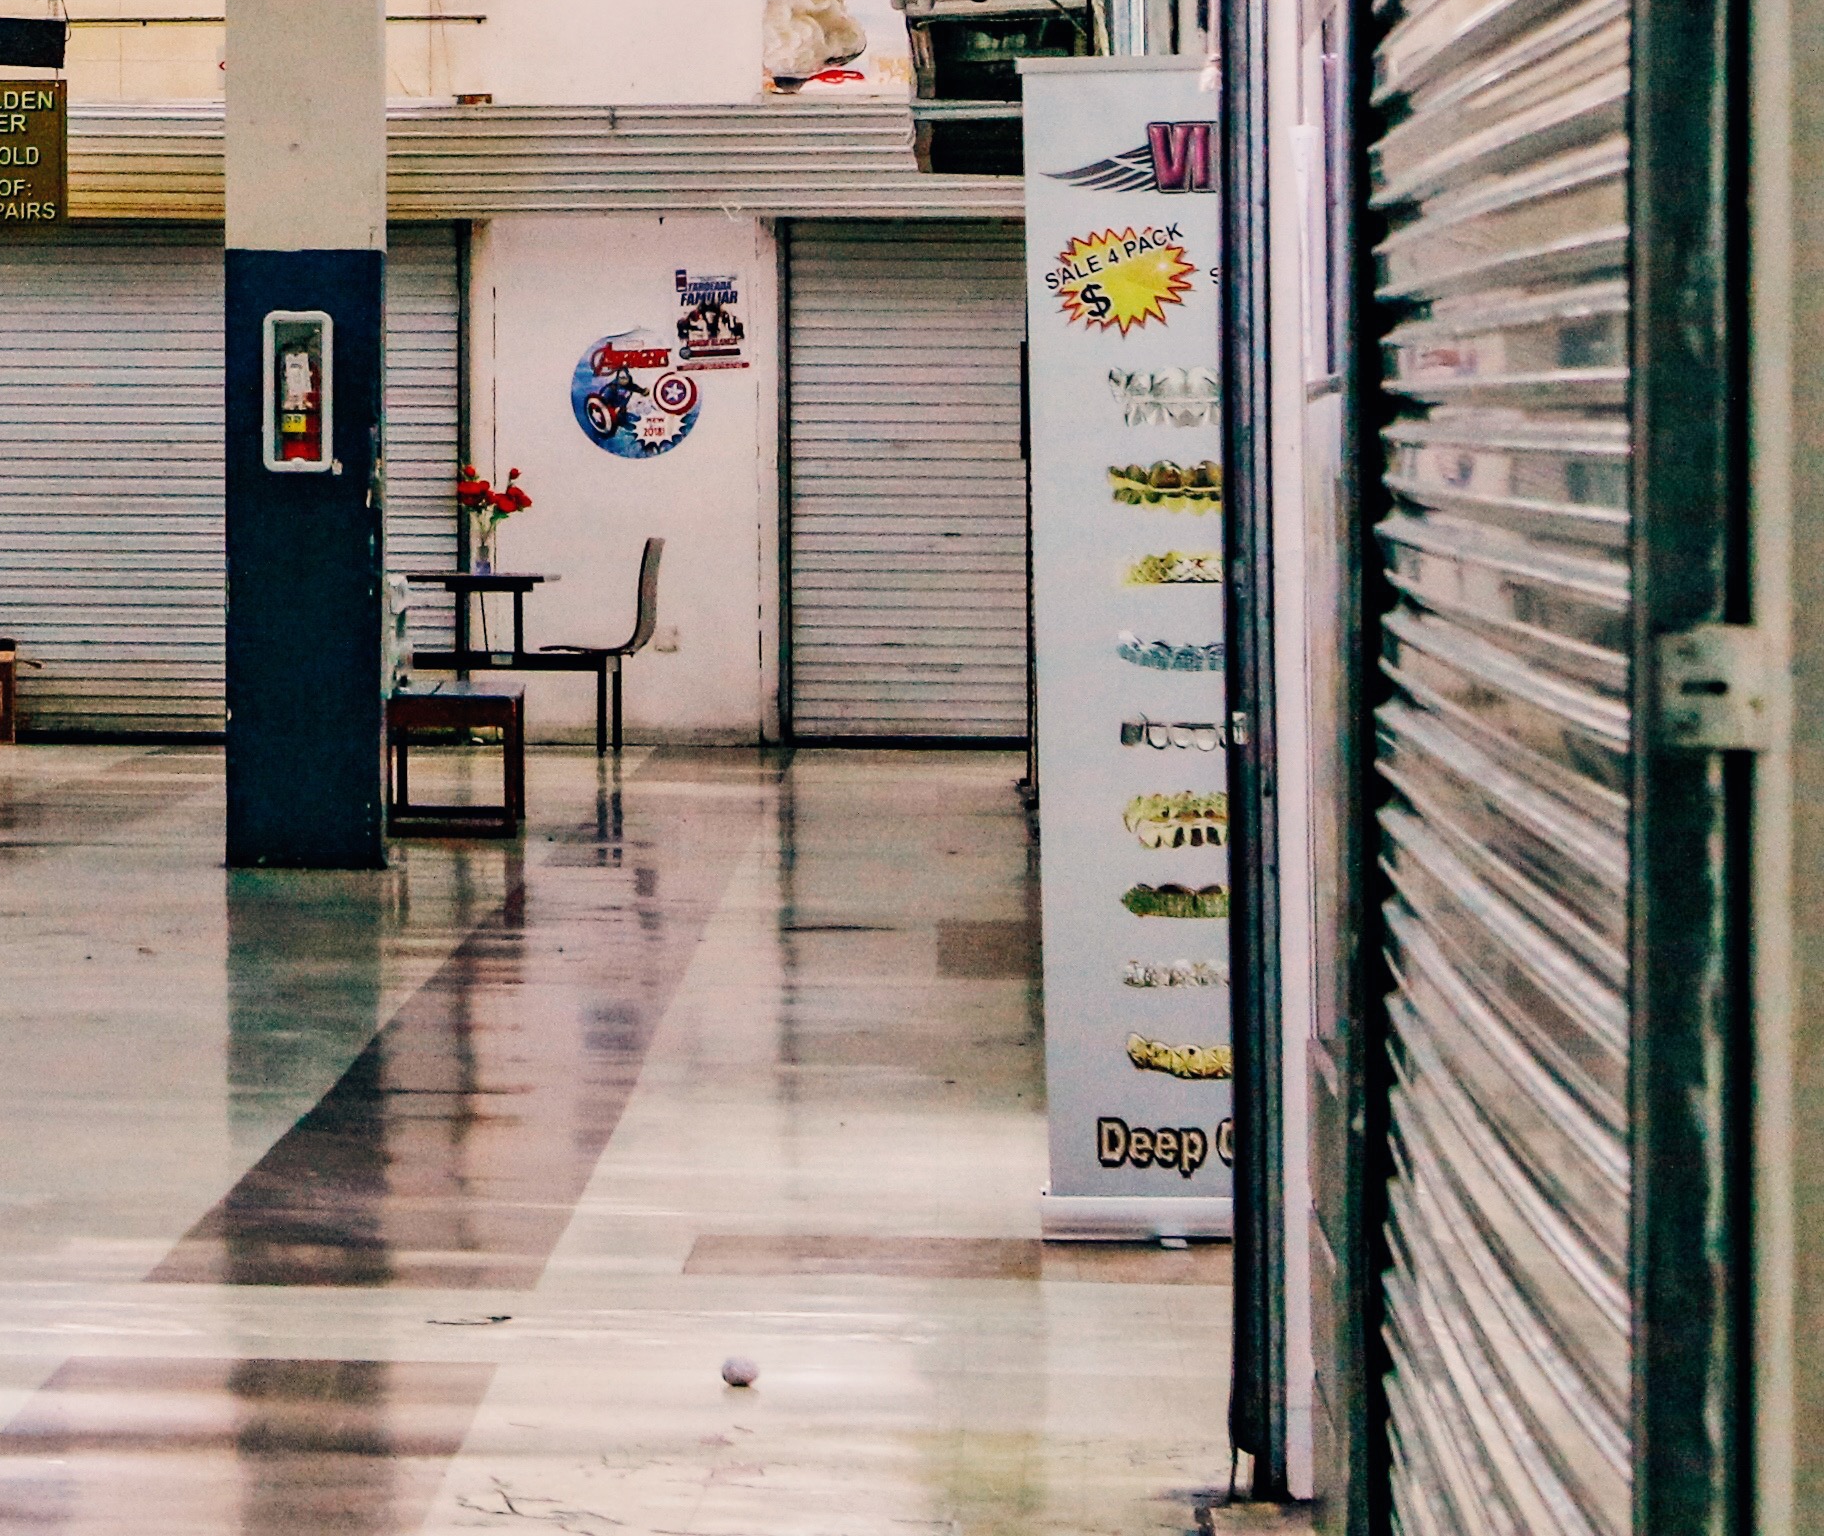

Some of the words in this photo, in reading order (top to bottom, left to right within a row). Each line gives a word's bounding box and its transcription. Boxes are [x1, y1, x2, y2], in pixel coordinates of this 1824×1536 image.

[1045, 255, 1103, 290] SALE
[1108, 248, 1119, 264] 4
[1123, 222, 1184, 258] PACK
[1080, 283, 1112, 318] $
[1097, 1117, 1208, 1178] Deep
